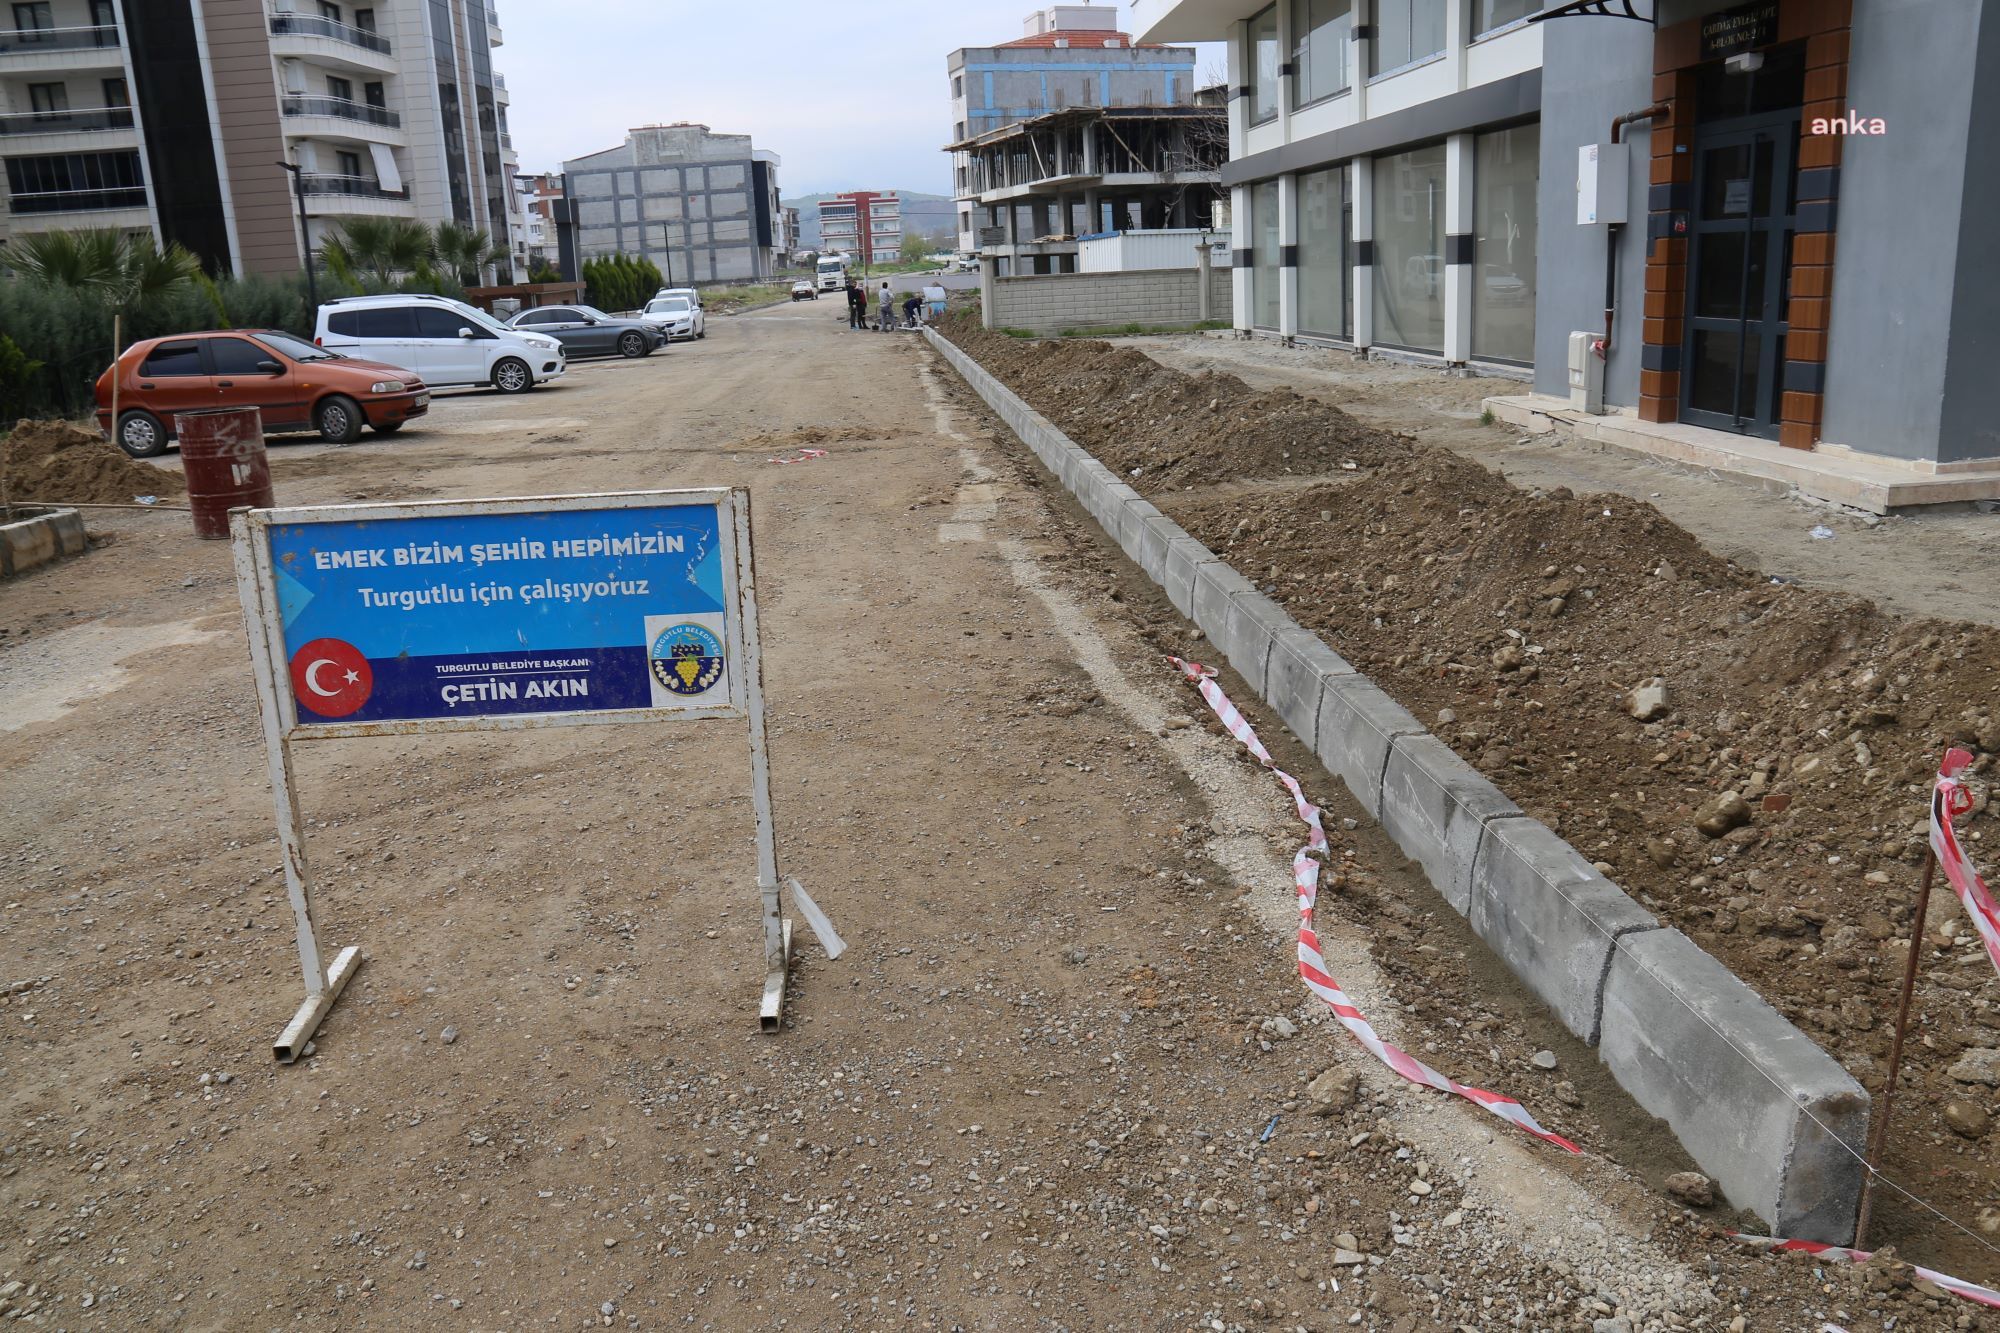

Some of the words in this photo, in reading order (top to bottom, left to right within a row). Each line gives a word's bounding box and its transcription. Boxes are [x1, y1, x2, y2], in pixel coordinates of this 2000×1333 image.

[315, 549, 388, 570] EMEK
[393, 541, 464, 566] BİZİM
[469, 536, 546, 567] ŞEHİR
[552, 530, 684, 559] HEPİMİZİN
[358, 583, 465, 611] Turgutlu
[470, 581, 513, 607] için
[519, 578, 649, 605] çalışıyoruz
[435, 663, 490, 673] TURGUTLU
[492, 659, 541, 670] BELEDİYE
[543, 658, 589, 669] BAŞKANI
[441, 677, 518, 708] ÇETİN
[524, 678, 589, 698] AKIN
